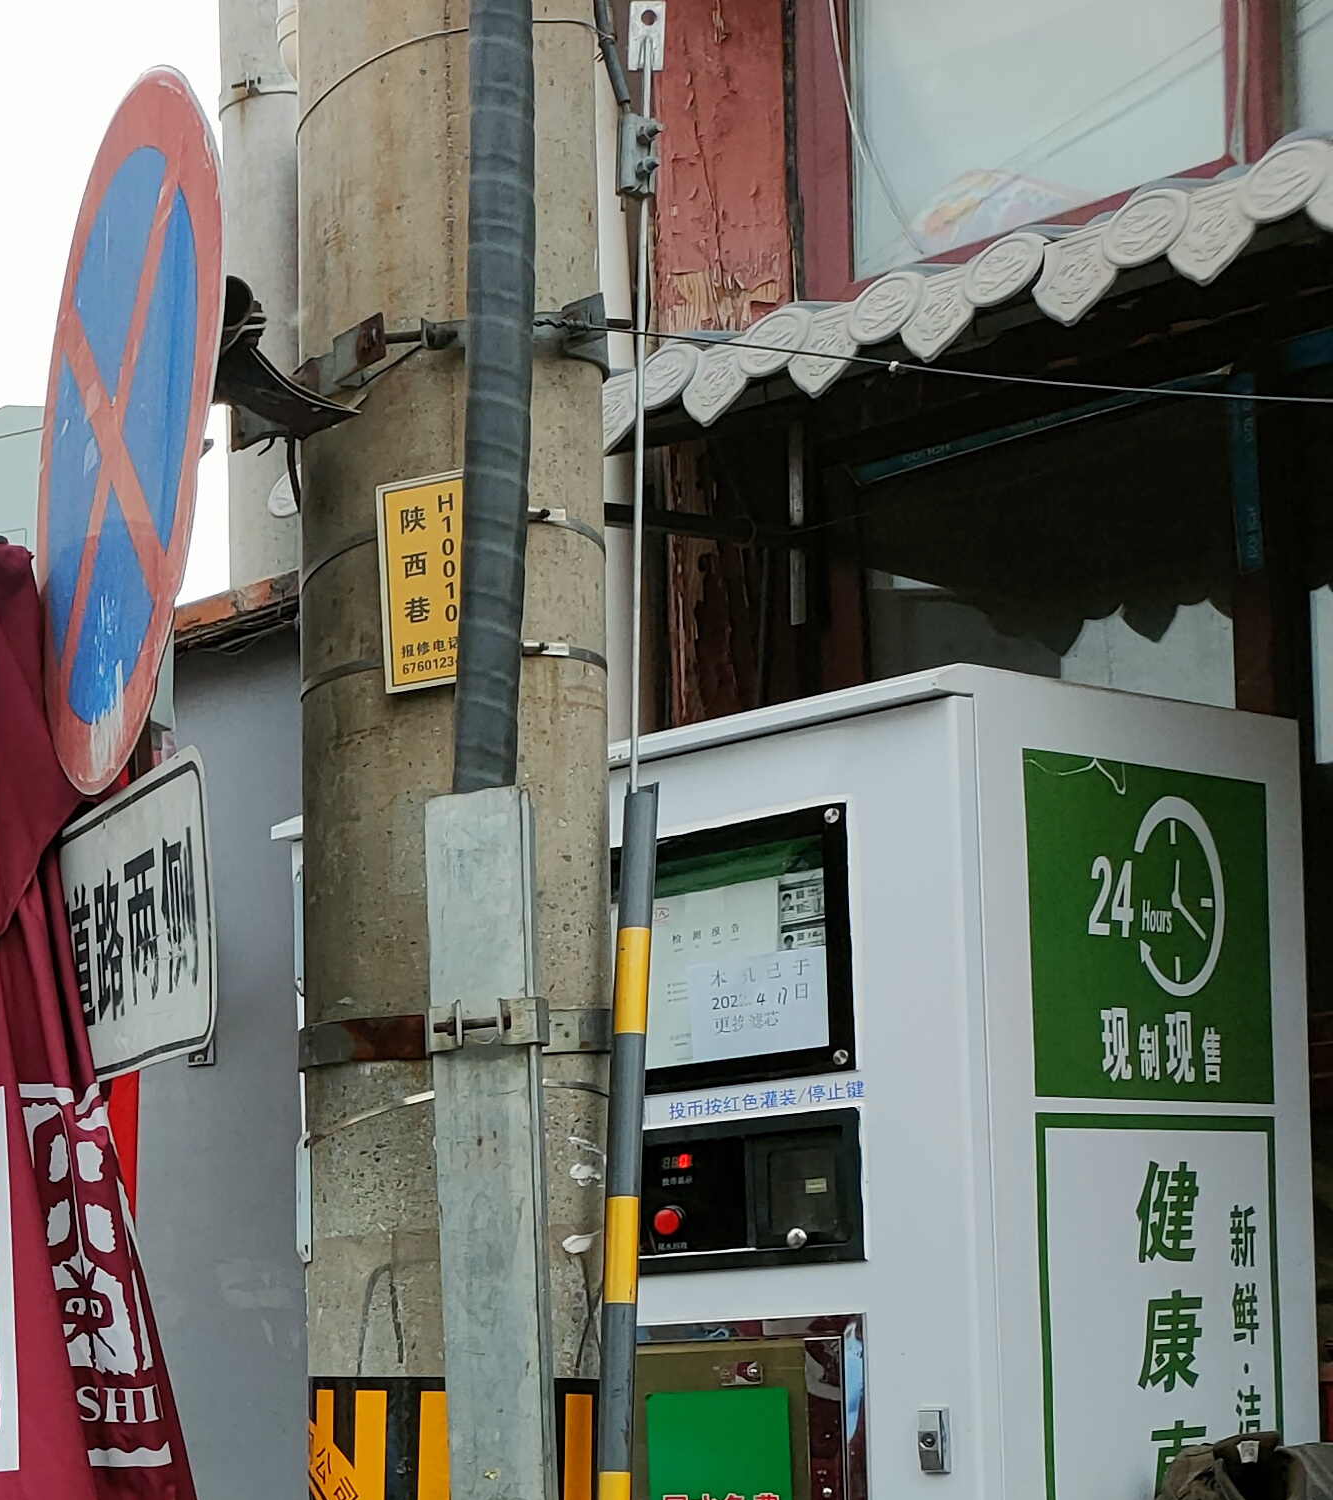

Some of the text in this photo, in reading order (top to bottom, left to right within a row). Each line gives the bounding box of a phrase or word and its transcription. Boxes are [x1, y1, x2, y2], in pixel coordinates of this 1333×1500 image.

[400, 506, 431, 624] 陕西巷
[437, 493, 458, 623] H10010
[402, 656, 458, 675] 6760123
[65, 826, 199, 1027] 道路两侧
[1088, 855, 1173, 938] 24 Hours
[1100, 1007, 1222, 1084] 现制现售
